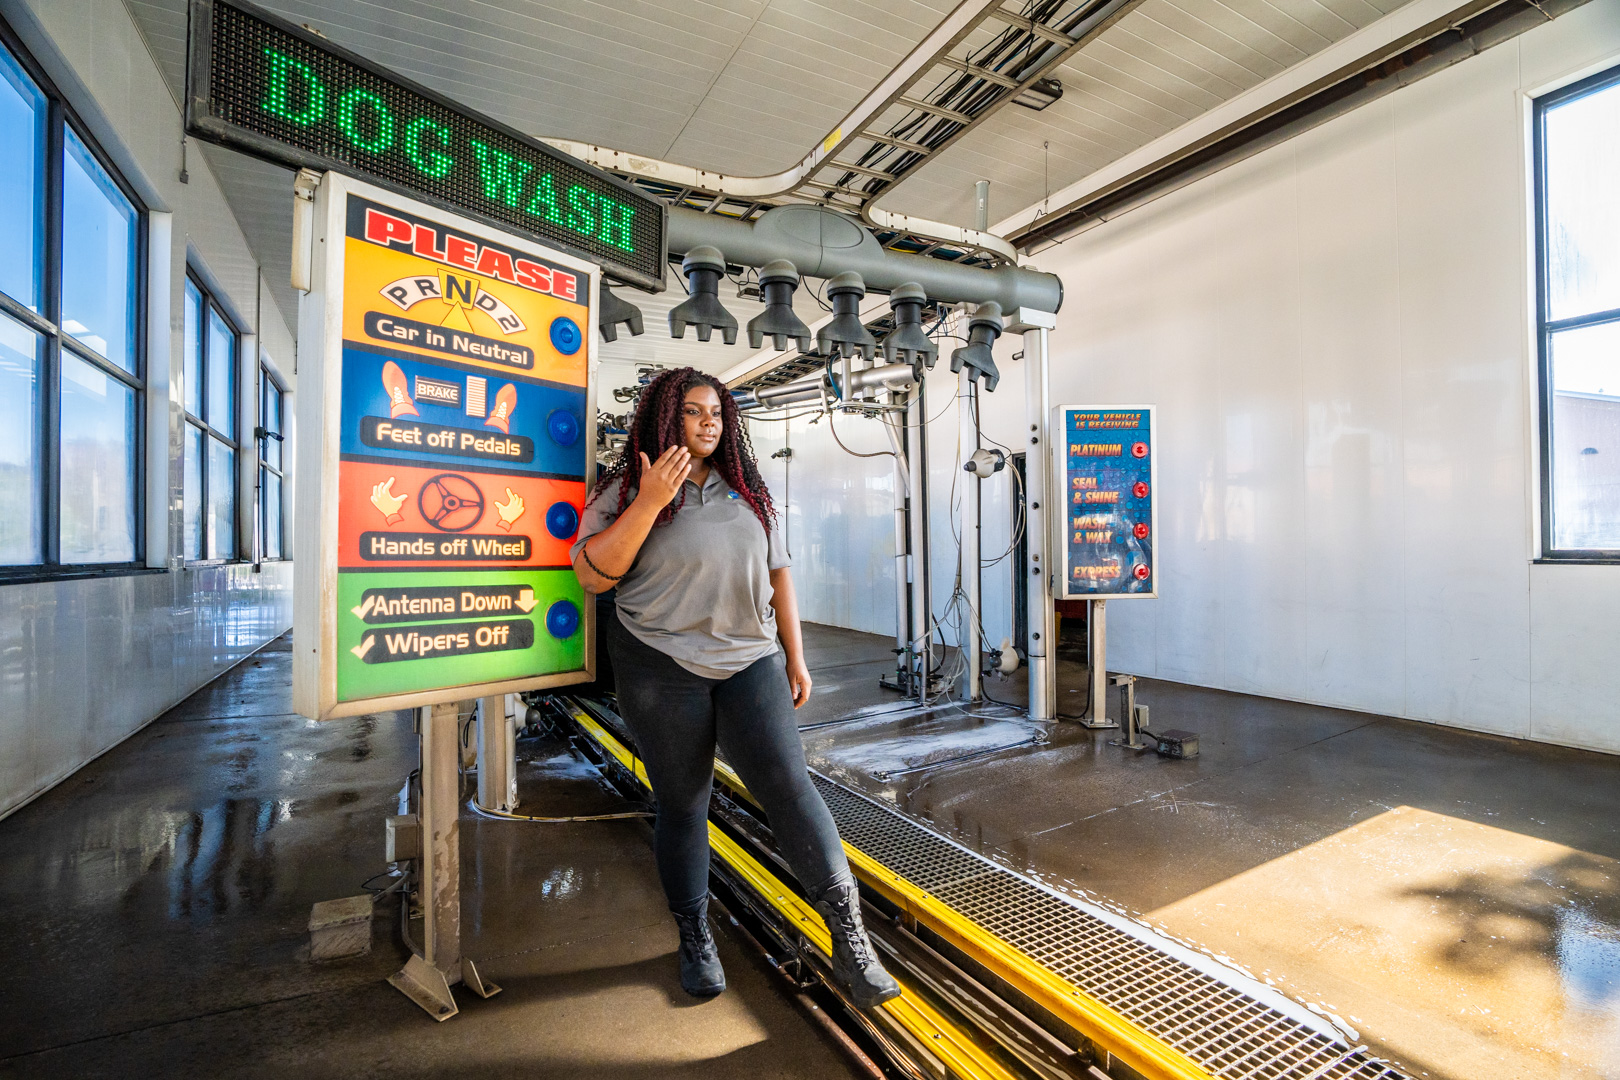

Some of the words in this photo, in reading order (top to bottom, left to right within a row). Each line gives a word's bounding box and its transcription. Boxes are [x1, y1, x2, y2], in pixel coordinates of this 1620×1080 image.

[262, 47, 454, 178] DOG
[471, 139, 635, 252] WASH
[365, 208, 577, 301] PLEASE
[376, 319, 419, 341] Car
[426, 328, 445, 347] in
[452, 333, 528, 365] Neutral
[417, 382, 458, 400] BRAKE
[1073, 413, 1100, 421] YOUR
[1103, 413, 1141, 421] VEHICLE
[1076, 421, 1086, 429] IS
[1088, 421, 1139, 429] RECEIVING
[376, 422, 422, 445] Feet
[426, 429, 456, 449] off
[460, 433, 521, 456] Pedals
[1069, 444, 1122, 457] PLATINUM
[1072, 477, 1098, 490] SEAL
[1072, 492, 1082, 504] &
[1085, 491, 1119, 504] SHINE
[1073, 517, 1107, 530] WASH
[1073, 532, 1082, 544] &
[1086, 531, 1113, 544] WAX
[370, 537, 435, 555] Hands
[440, 538, 468, 555] off
[472, 539, 525, 556] Wheel
[1073, 565, 1121, 579] EXPRESS
[372, 595, 455, 616] Antenna
[461, 592, 512, 611] Down
[385, 631, 469, 655] Wipers
[475, 626, 510, 646] Off
